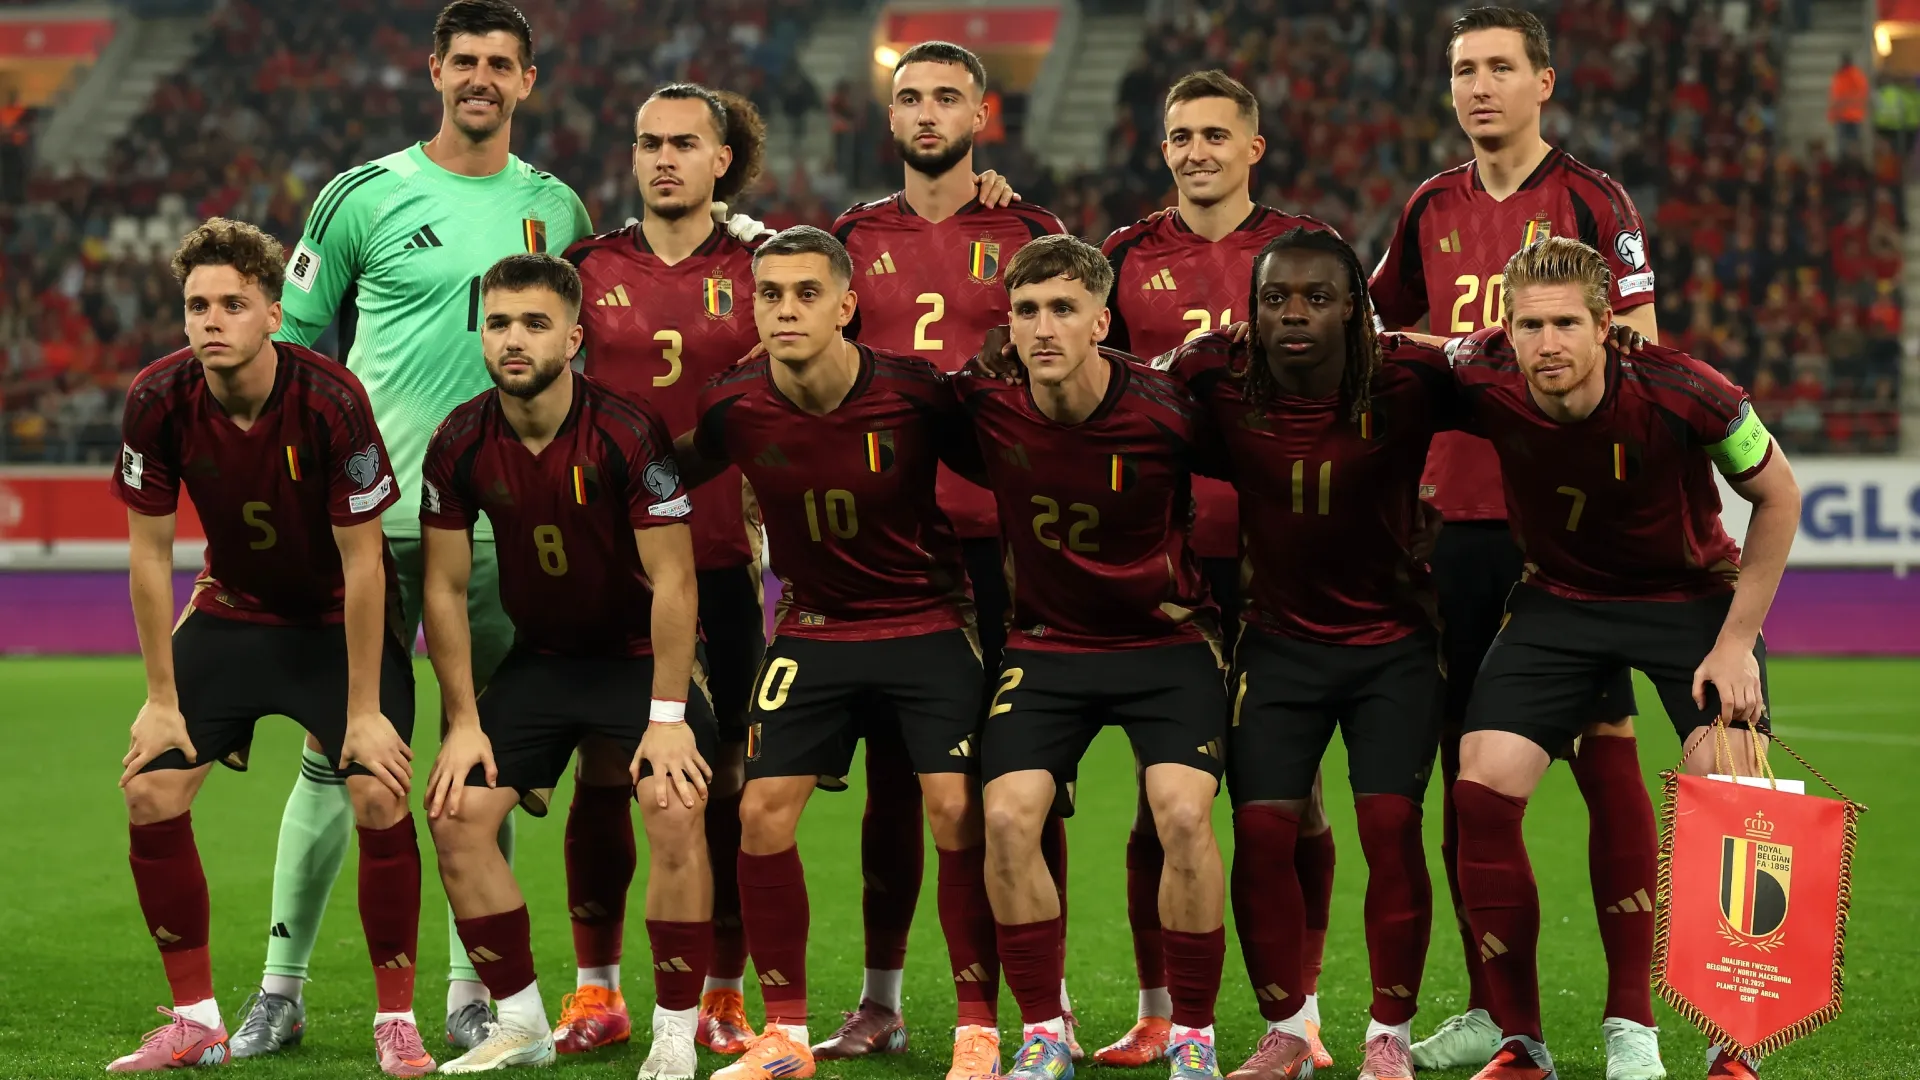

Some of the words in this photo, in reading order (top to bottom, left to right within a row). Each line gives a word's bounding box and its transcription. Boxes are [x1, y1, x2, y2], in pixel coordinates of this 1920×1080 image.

[467, 275, 481, 332] 1
[913, 292, 945, 351] 2
[1450, 273, 1506, 333] 20
[652, 329, 683, 388] 3
[1291, 459, 1332, 515] 11
[1556, 485, 1587, 532] 7
[242, 501, 277, 550] 5
[803, 488, 859, 542] 10
[1030, 494, 1100, 552] 22
[533, 524, 568, 577] 8
[1757, 844, 1782, 855] ROYAL
[1757, 852, 1790, 864] BELGIAN
[1706, 962, 1731, 973] BELGIUM
[1737, 968, 1757, 978] NORTH
[1758, 972, 1792, 984] MACEDONIA
[1716, 981, 1737, 992] PLANET
[1738, 985, 1759, 995] GROUP
[1760, 989, 1780, 999] ARENA
[1721, 956, 1750, 968] QUALIFIER
[1751, 962, 1779, 973] FWC2026
[1732, 976, 1765, 988] 10.10.2025
